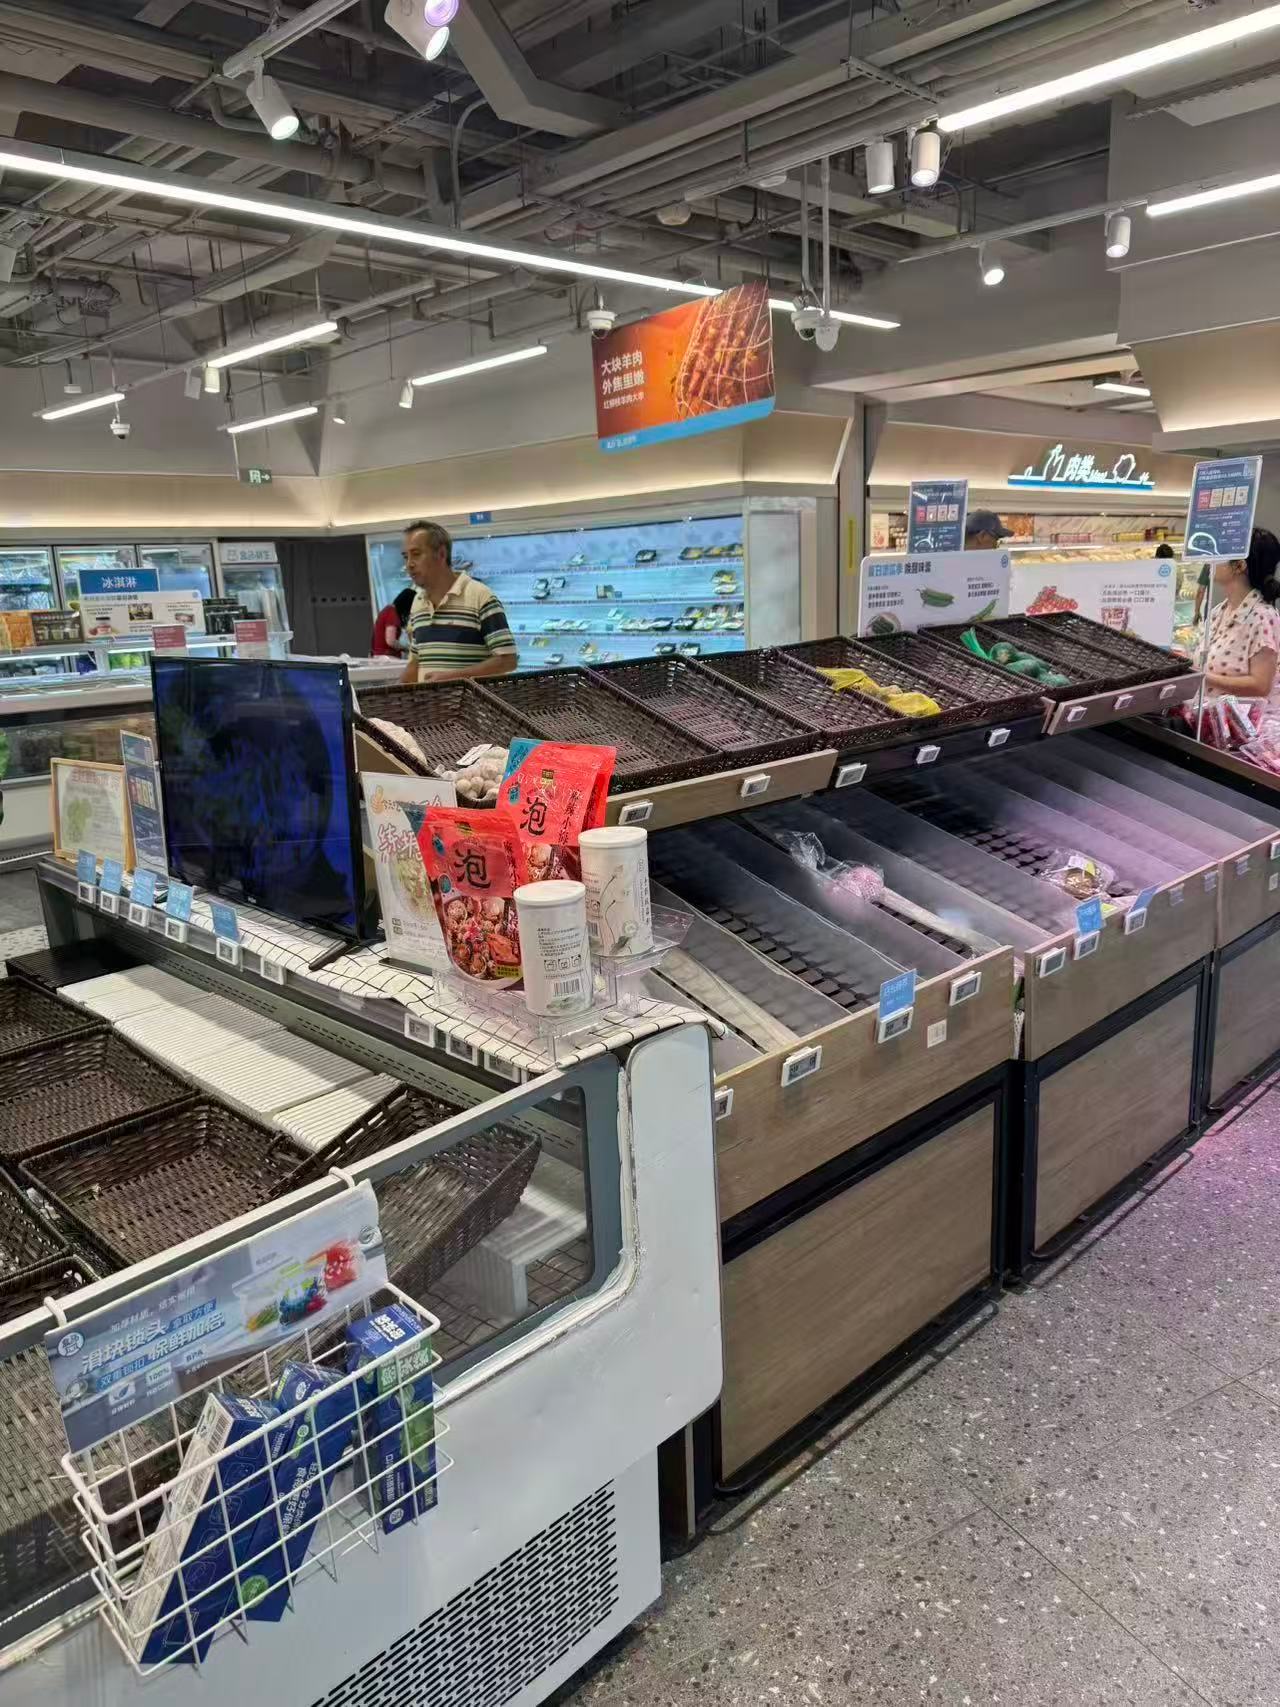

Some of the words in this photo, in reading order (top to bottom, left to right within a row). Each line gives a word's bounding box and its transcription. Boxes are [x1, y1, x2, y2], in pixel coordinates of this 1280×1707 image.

[601, 350, 643, 376] 大块羊肉
[602, 371, 645, 396] 外焦里嫩
[101, 576, 137, 588] 冰淇淋
[520, 796, 547, 836] 泡
[454, 849, 491, 888] 泡
[148, 1312, 225, 1361] 保鲜加倍
